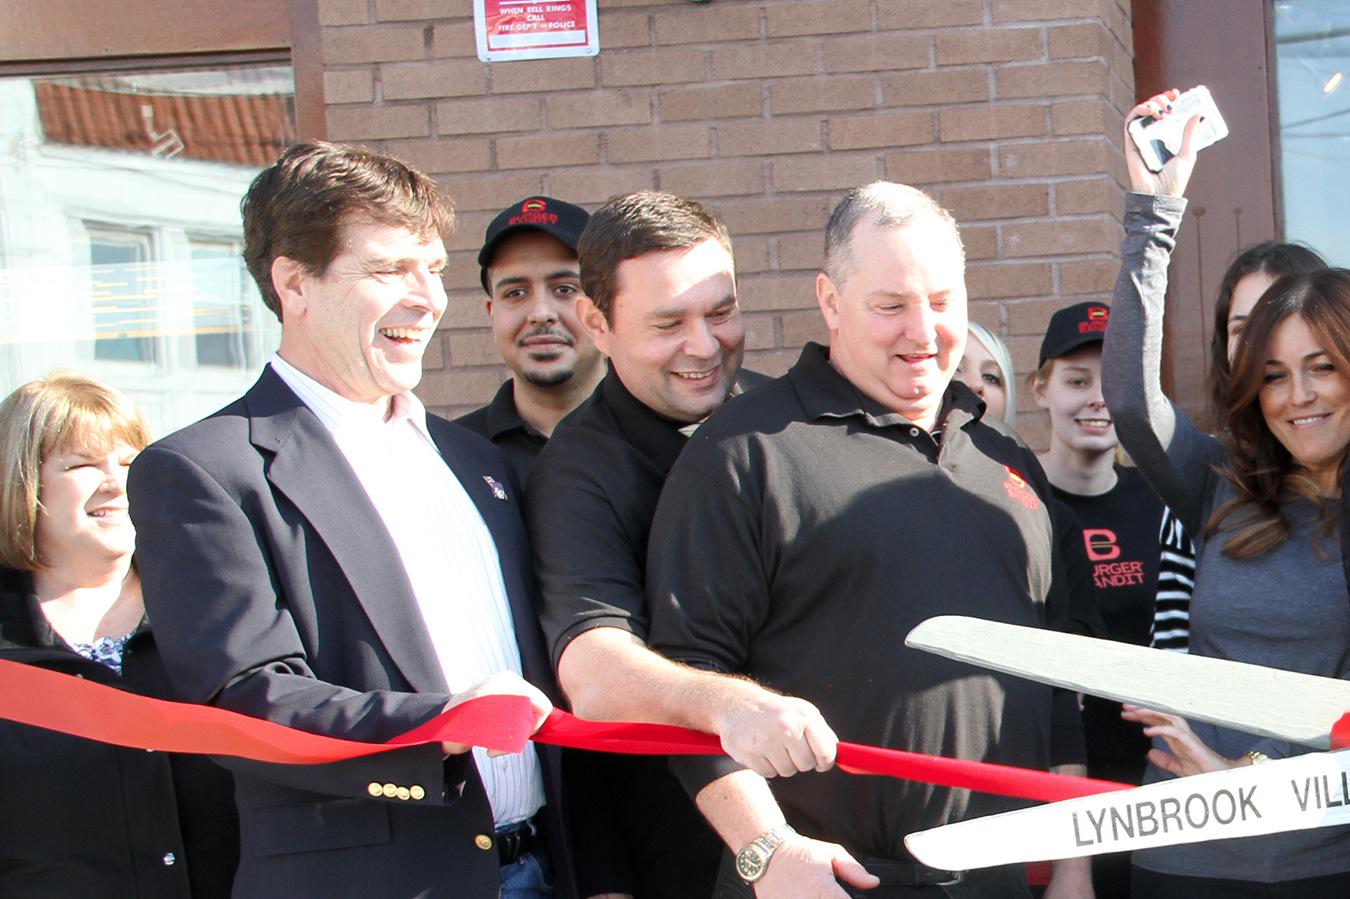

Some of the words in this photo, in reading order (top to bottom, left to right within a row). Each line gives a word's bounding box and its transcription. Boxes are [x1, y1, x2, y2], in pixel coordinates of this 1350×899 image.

[500, 7, 524, 15] WHEN
[546, 4, 572, 12] RINGS
[548, 20, 576, 28] POLICE
[1083, 529, 1120, 561] B
[1072, 785, 1262, 847] LYNBROOK
